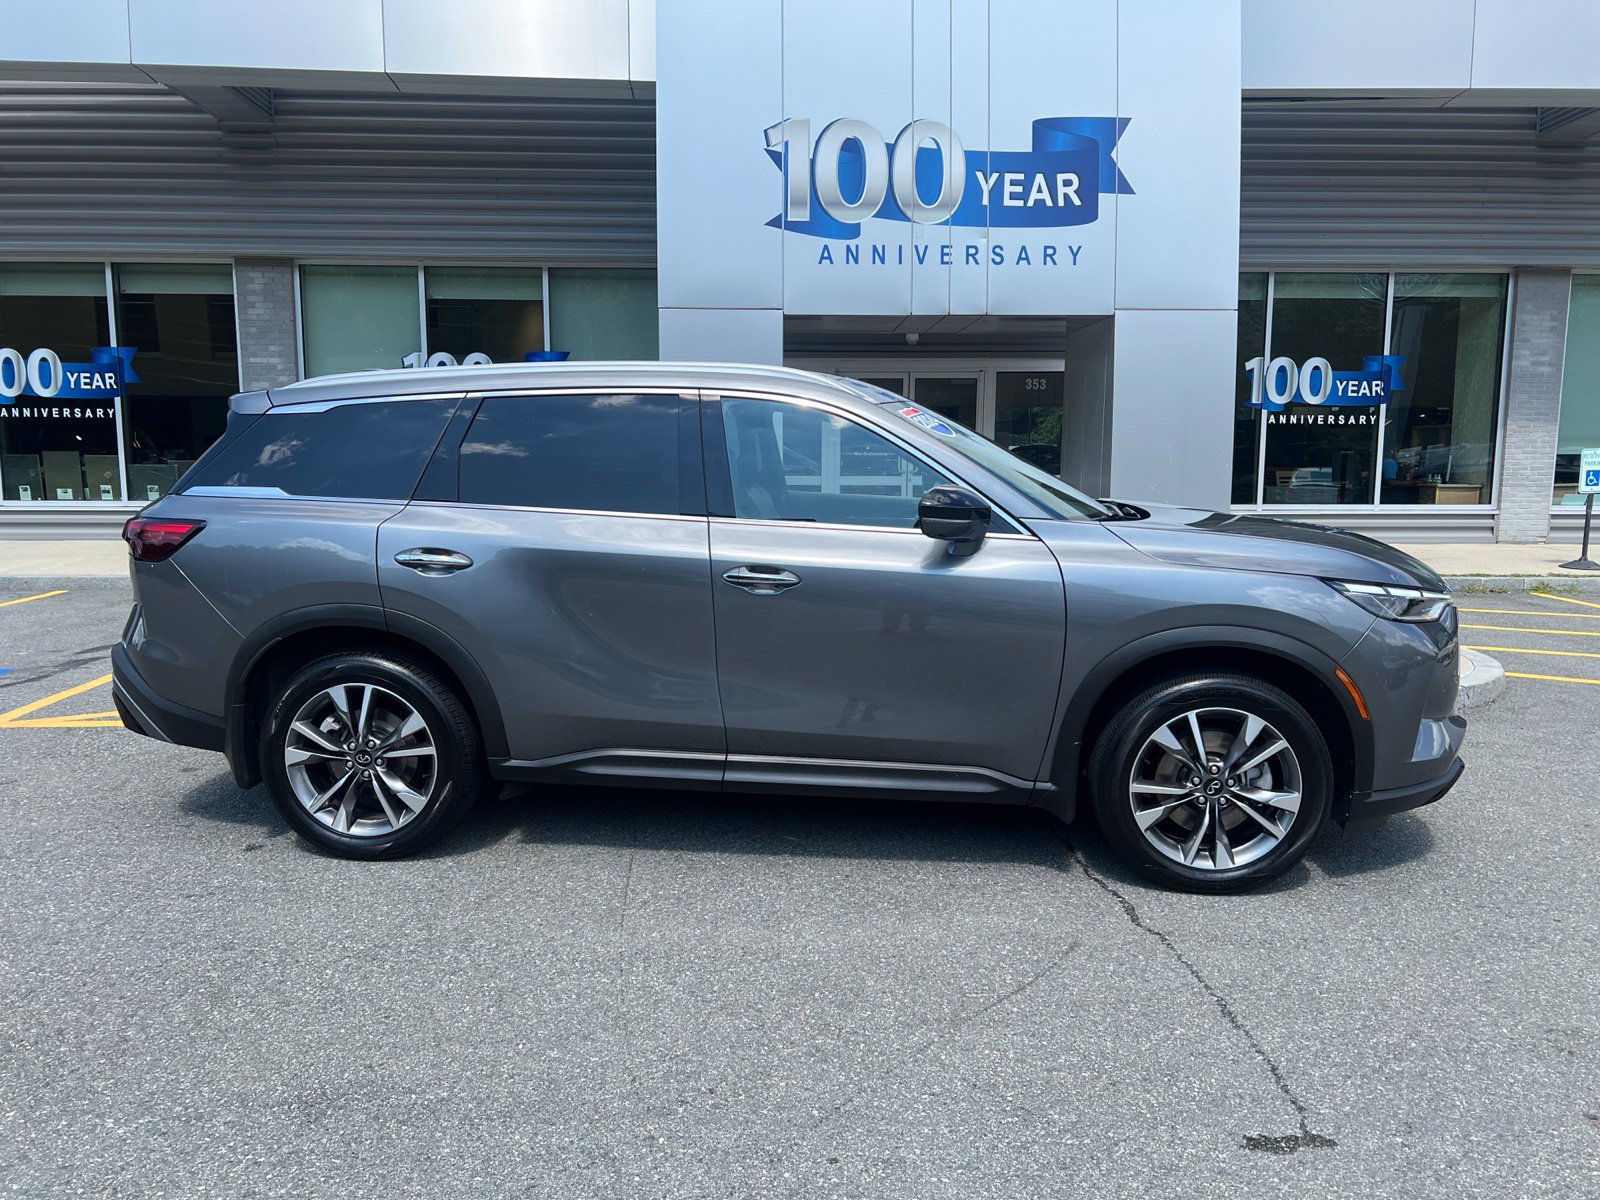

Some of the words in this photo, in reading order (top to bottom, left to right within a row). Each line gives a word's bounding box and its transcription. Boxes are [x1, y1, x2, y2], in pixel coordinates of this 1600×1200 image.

[763, 117, 966, 224] 100
[975, 170, 1082, 208] YEAR
[818, 244, 1083, 266] ANNIVERSARY
[0, 348, 63, 398] 00
[66, 371, 118, 389] YEAR
[1025, 378, 1047, 390] 353
[1244, 356, 1333, 405] 100
[1336, 380, 1385, 397] YEAR
[0, 407, 115, 418] ANNIVERSARY
[1268, 414, 1377, 425] ANNIVERSARY
